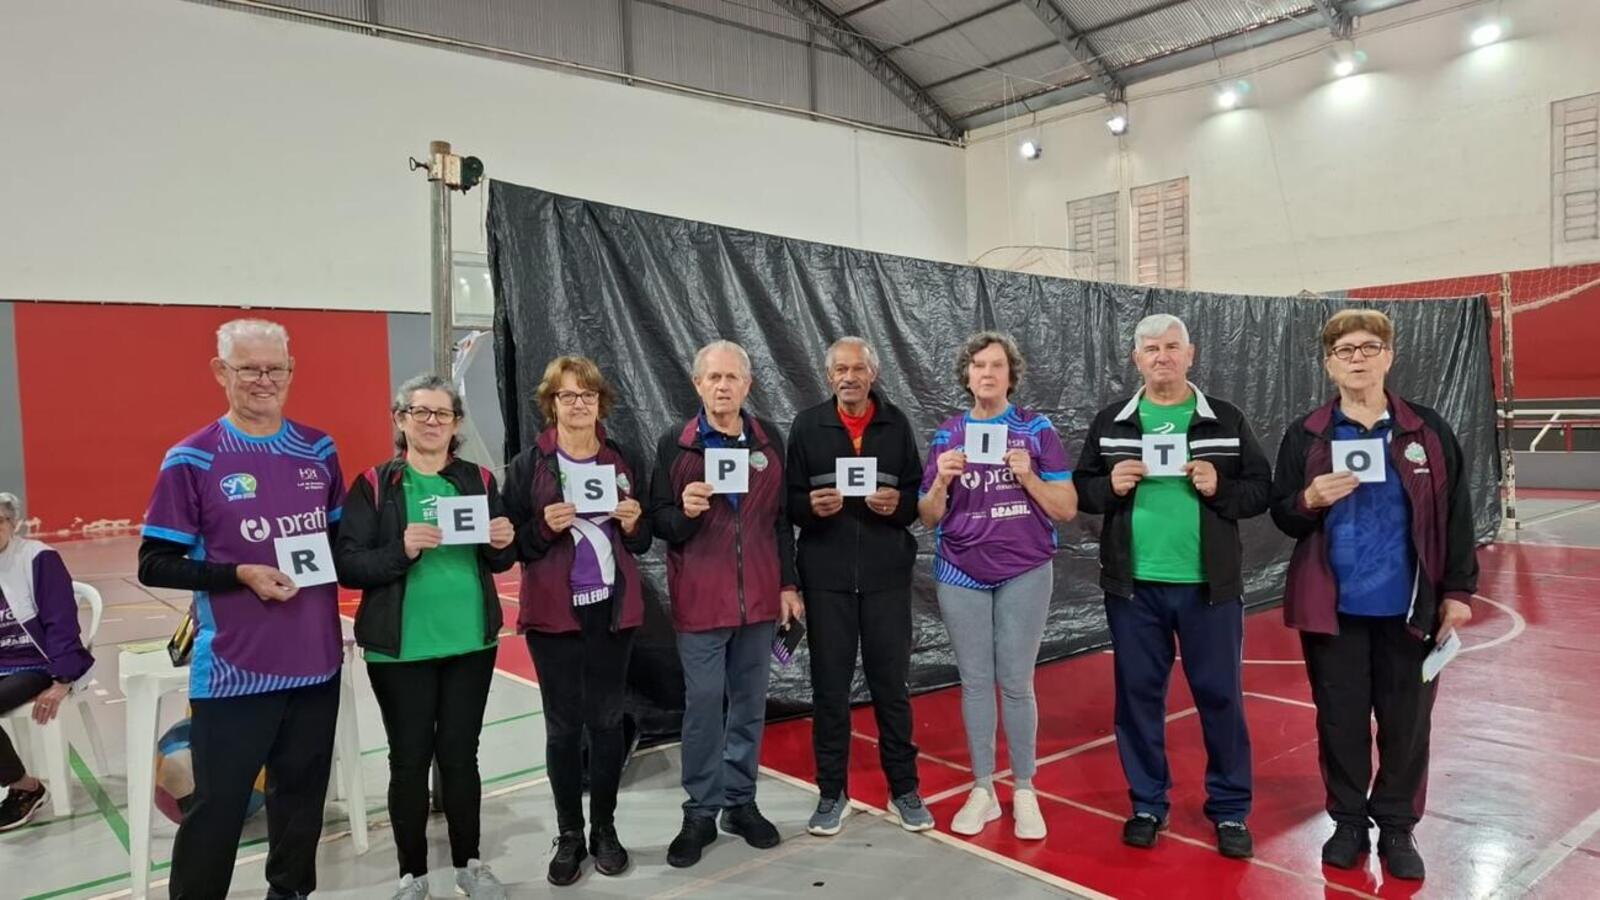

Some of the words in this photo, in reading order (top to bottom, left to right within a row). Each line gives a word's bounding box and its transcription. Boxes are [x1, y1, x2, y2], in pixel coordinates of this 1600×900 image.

[981, 432, 990, 454] I
[1153, 443, 1175, 466] T
[1345, 450, 1372, 472] O
[718, 459, 737, 481] P
[847, 466, 866, 487] E
[984, 466, 1015, 492] pra
[584, 478, 604, 500] S
[275, 505, 327, 538] prati
[453, 507, 476, 532] E
[290, 549, 320, 575] R
[572, 586, 609, 607] TOLEDO
